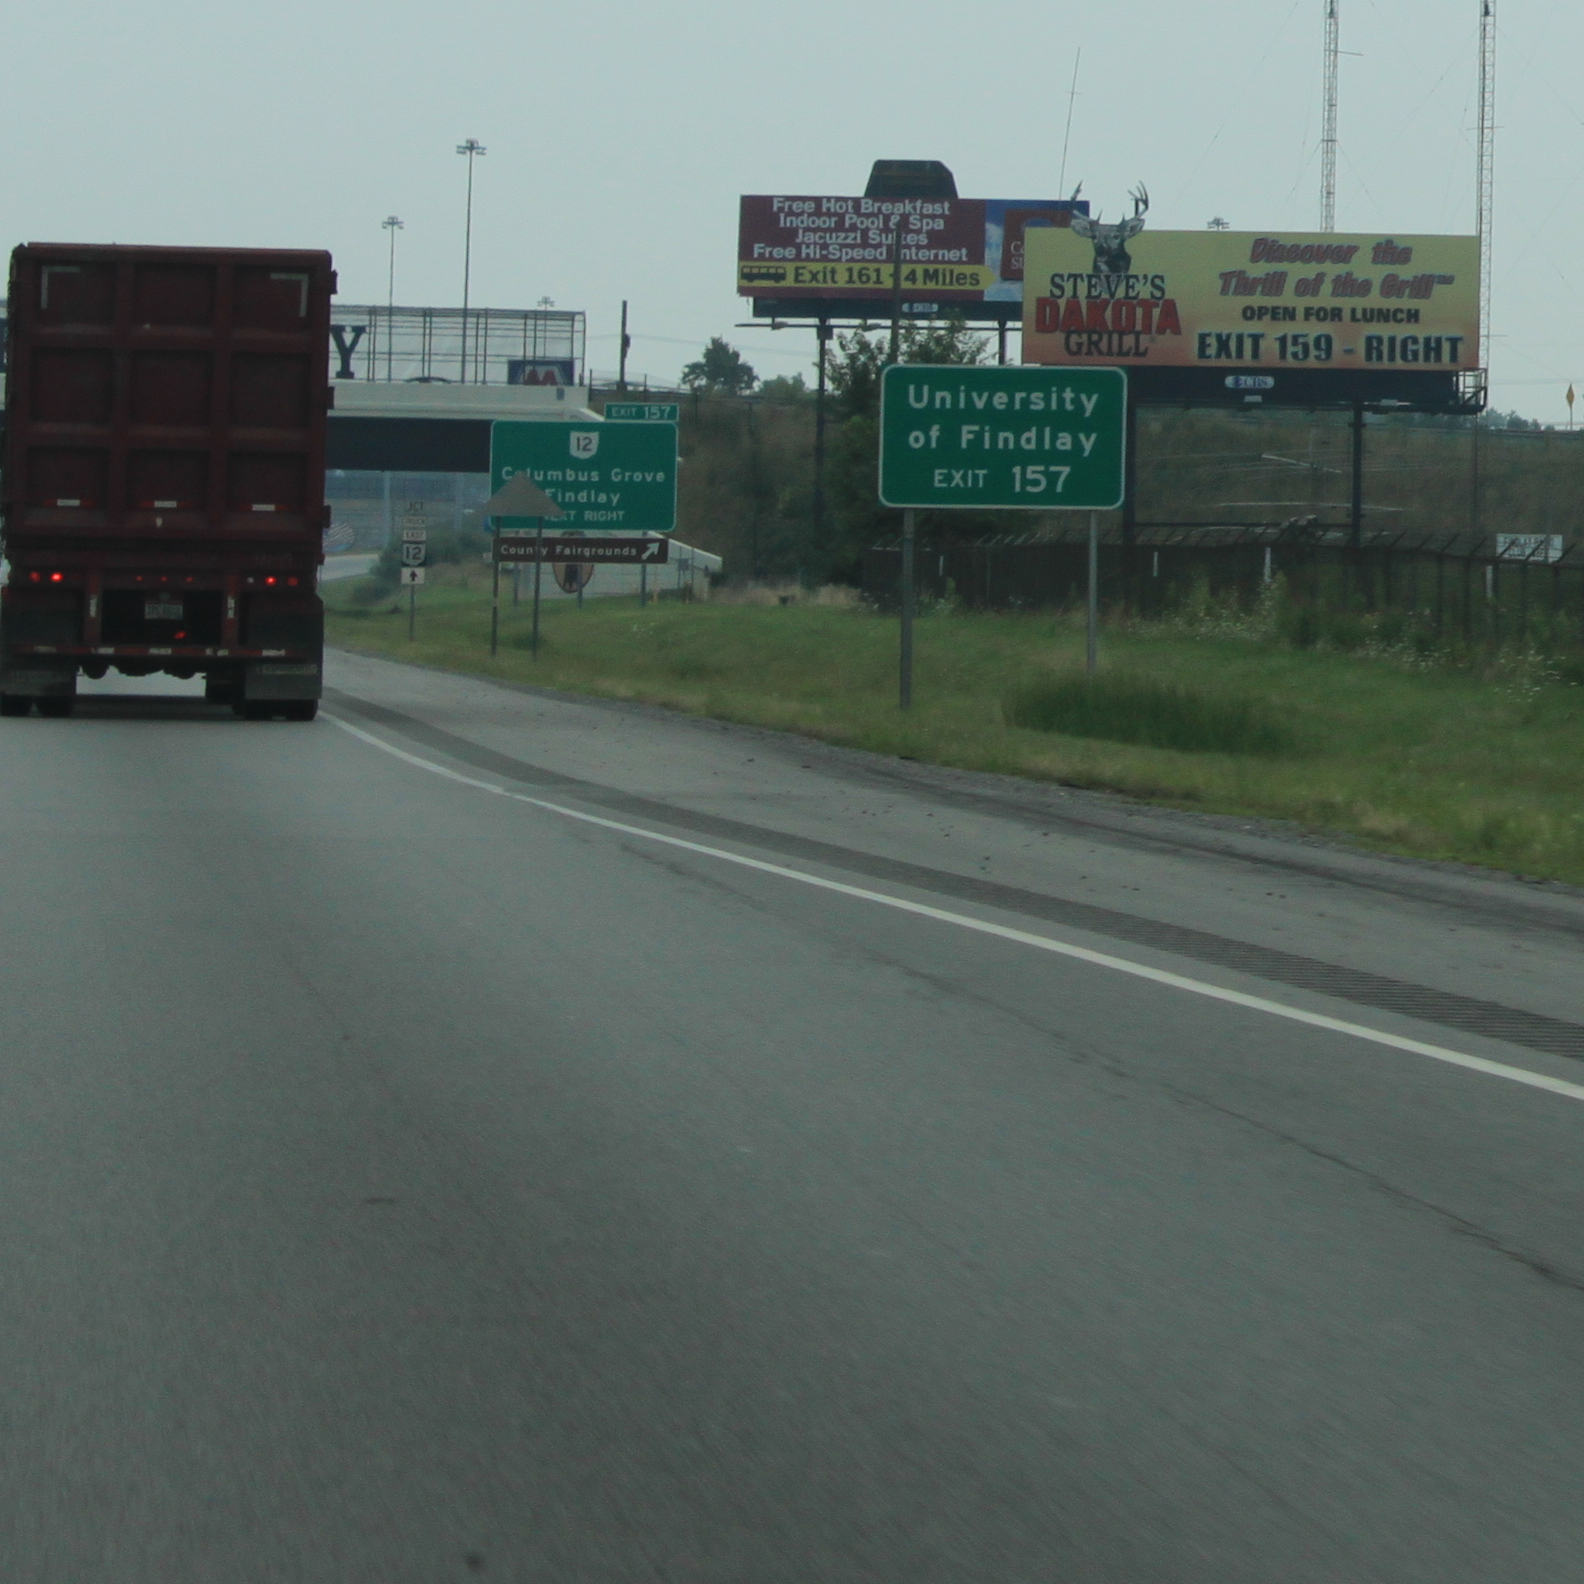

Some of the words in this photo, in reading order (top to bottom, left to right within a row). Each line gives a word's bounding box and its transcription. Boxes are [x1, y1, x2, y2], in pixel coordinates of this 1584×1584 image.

[772, 197, 815, 213] Free
[822, 198, 854, 213] Hot
[860, 199, 950, 215] Breakfast
[779, 214, 838, 229] Indoor
[845, 215, 883, 229] Pool
[888, 215, 900, 229] &
[908, 216, 945, 231] Spa
[795, 229, 861, 244] Jacuzzi
[752, 244, 796, 259] Free
[801, 244, 887, 263] Hi-Speed
[1250, 237, 1360, 265] Discover
[1371, 239, 1413, 265] the
[793, 266, 838, 285] Exit
[844, 267, 884, 286] 161
[903, 268, 919, 286] 4
[922, 268, 981, 287] Miles
[1218, 270, 1288, 297] Thrill
[1294, 272, 1326, 298] of
[1331, 272, 1373, 298] the
[1049, 273, 1166, 301] STEVE'S
[1035, 296, 1182, 336] DAKOTA
[1241, 305, 1297, 322] OPEN
[1303, 306, 1343, 322] FOR
[1350, 307, 1420, 324] LUNCH
[1063, 330, 1149, 358] GRILL
[1197, 332, 1265, 360] EXIT
[1275, 332, 1333, 361] 159
[1364, 334, 1464, 364] RIGHT
[907, 384, 1099, 417] University
[611, 406, 637, 417] EXIT
[644, 406, 671, 419] 157
[576, 436, 593, 452] 12
[908, 424, 941, 449] of
[960, 425, 1098, 457] Findlay
[611, 468, 666, 483] Grove
[933, 469, 988, 489] EXIT
[1012, 466, 1071, 493] 157
[584, 510, 625, 522] RIGHT
[406, 546, 422, 560] 12
[555, 545, 637, 558] Fairgrounds
